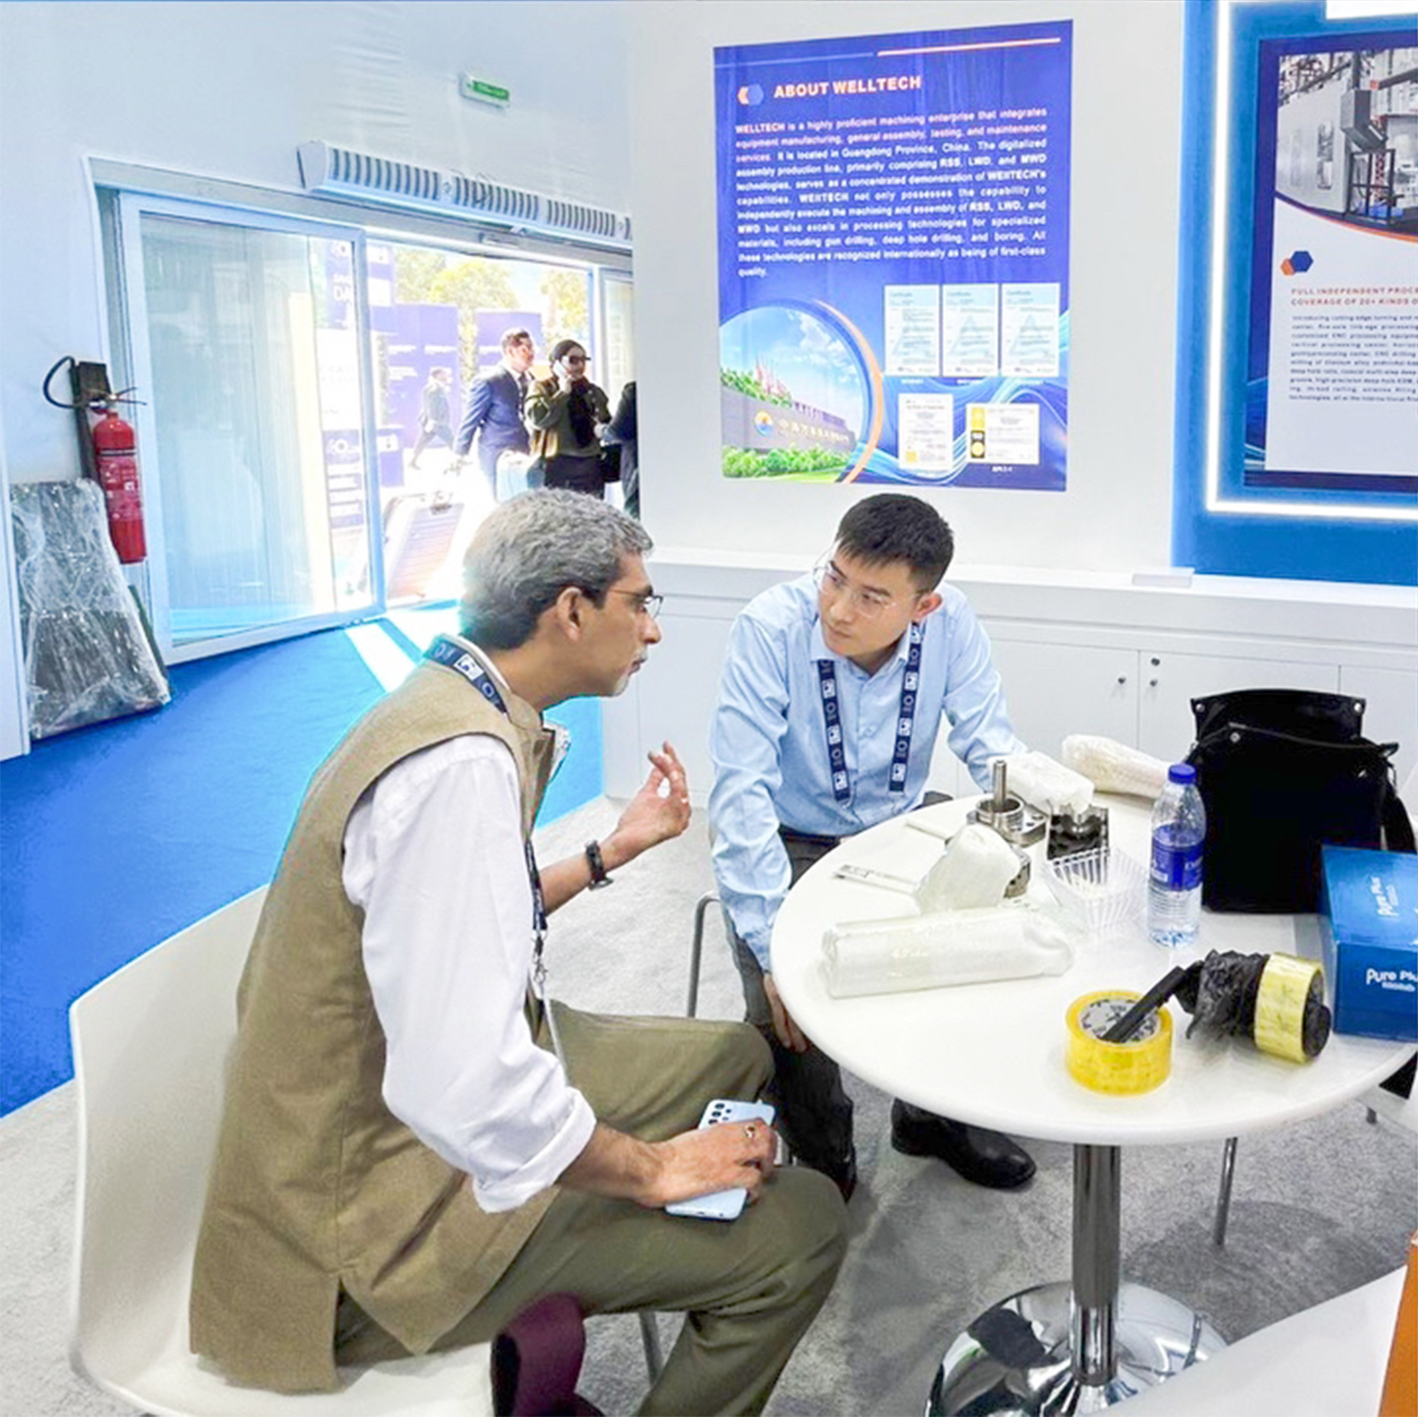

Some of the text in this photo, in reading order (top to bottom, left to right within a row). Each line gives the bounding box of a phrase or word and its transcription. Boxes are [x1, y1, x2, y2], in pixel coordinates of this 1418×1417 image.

[774, 76, 922, 98] ABOUT WELLTECH
[1366, 967, 1397, 985] Pure
